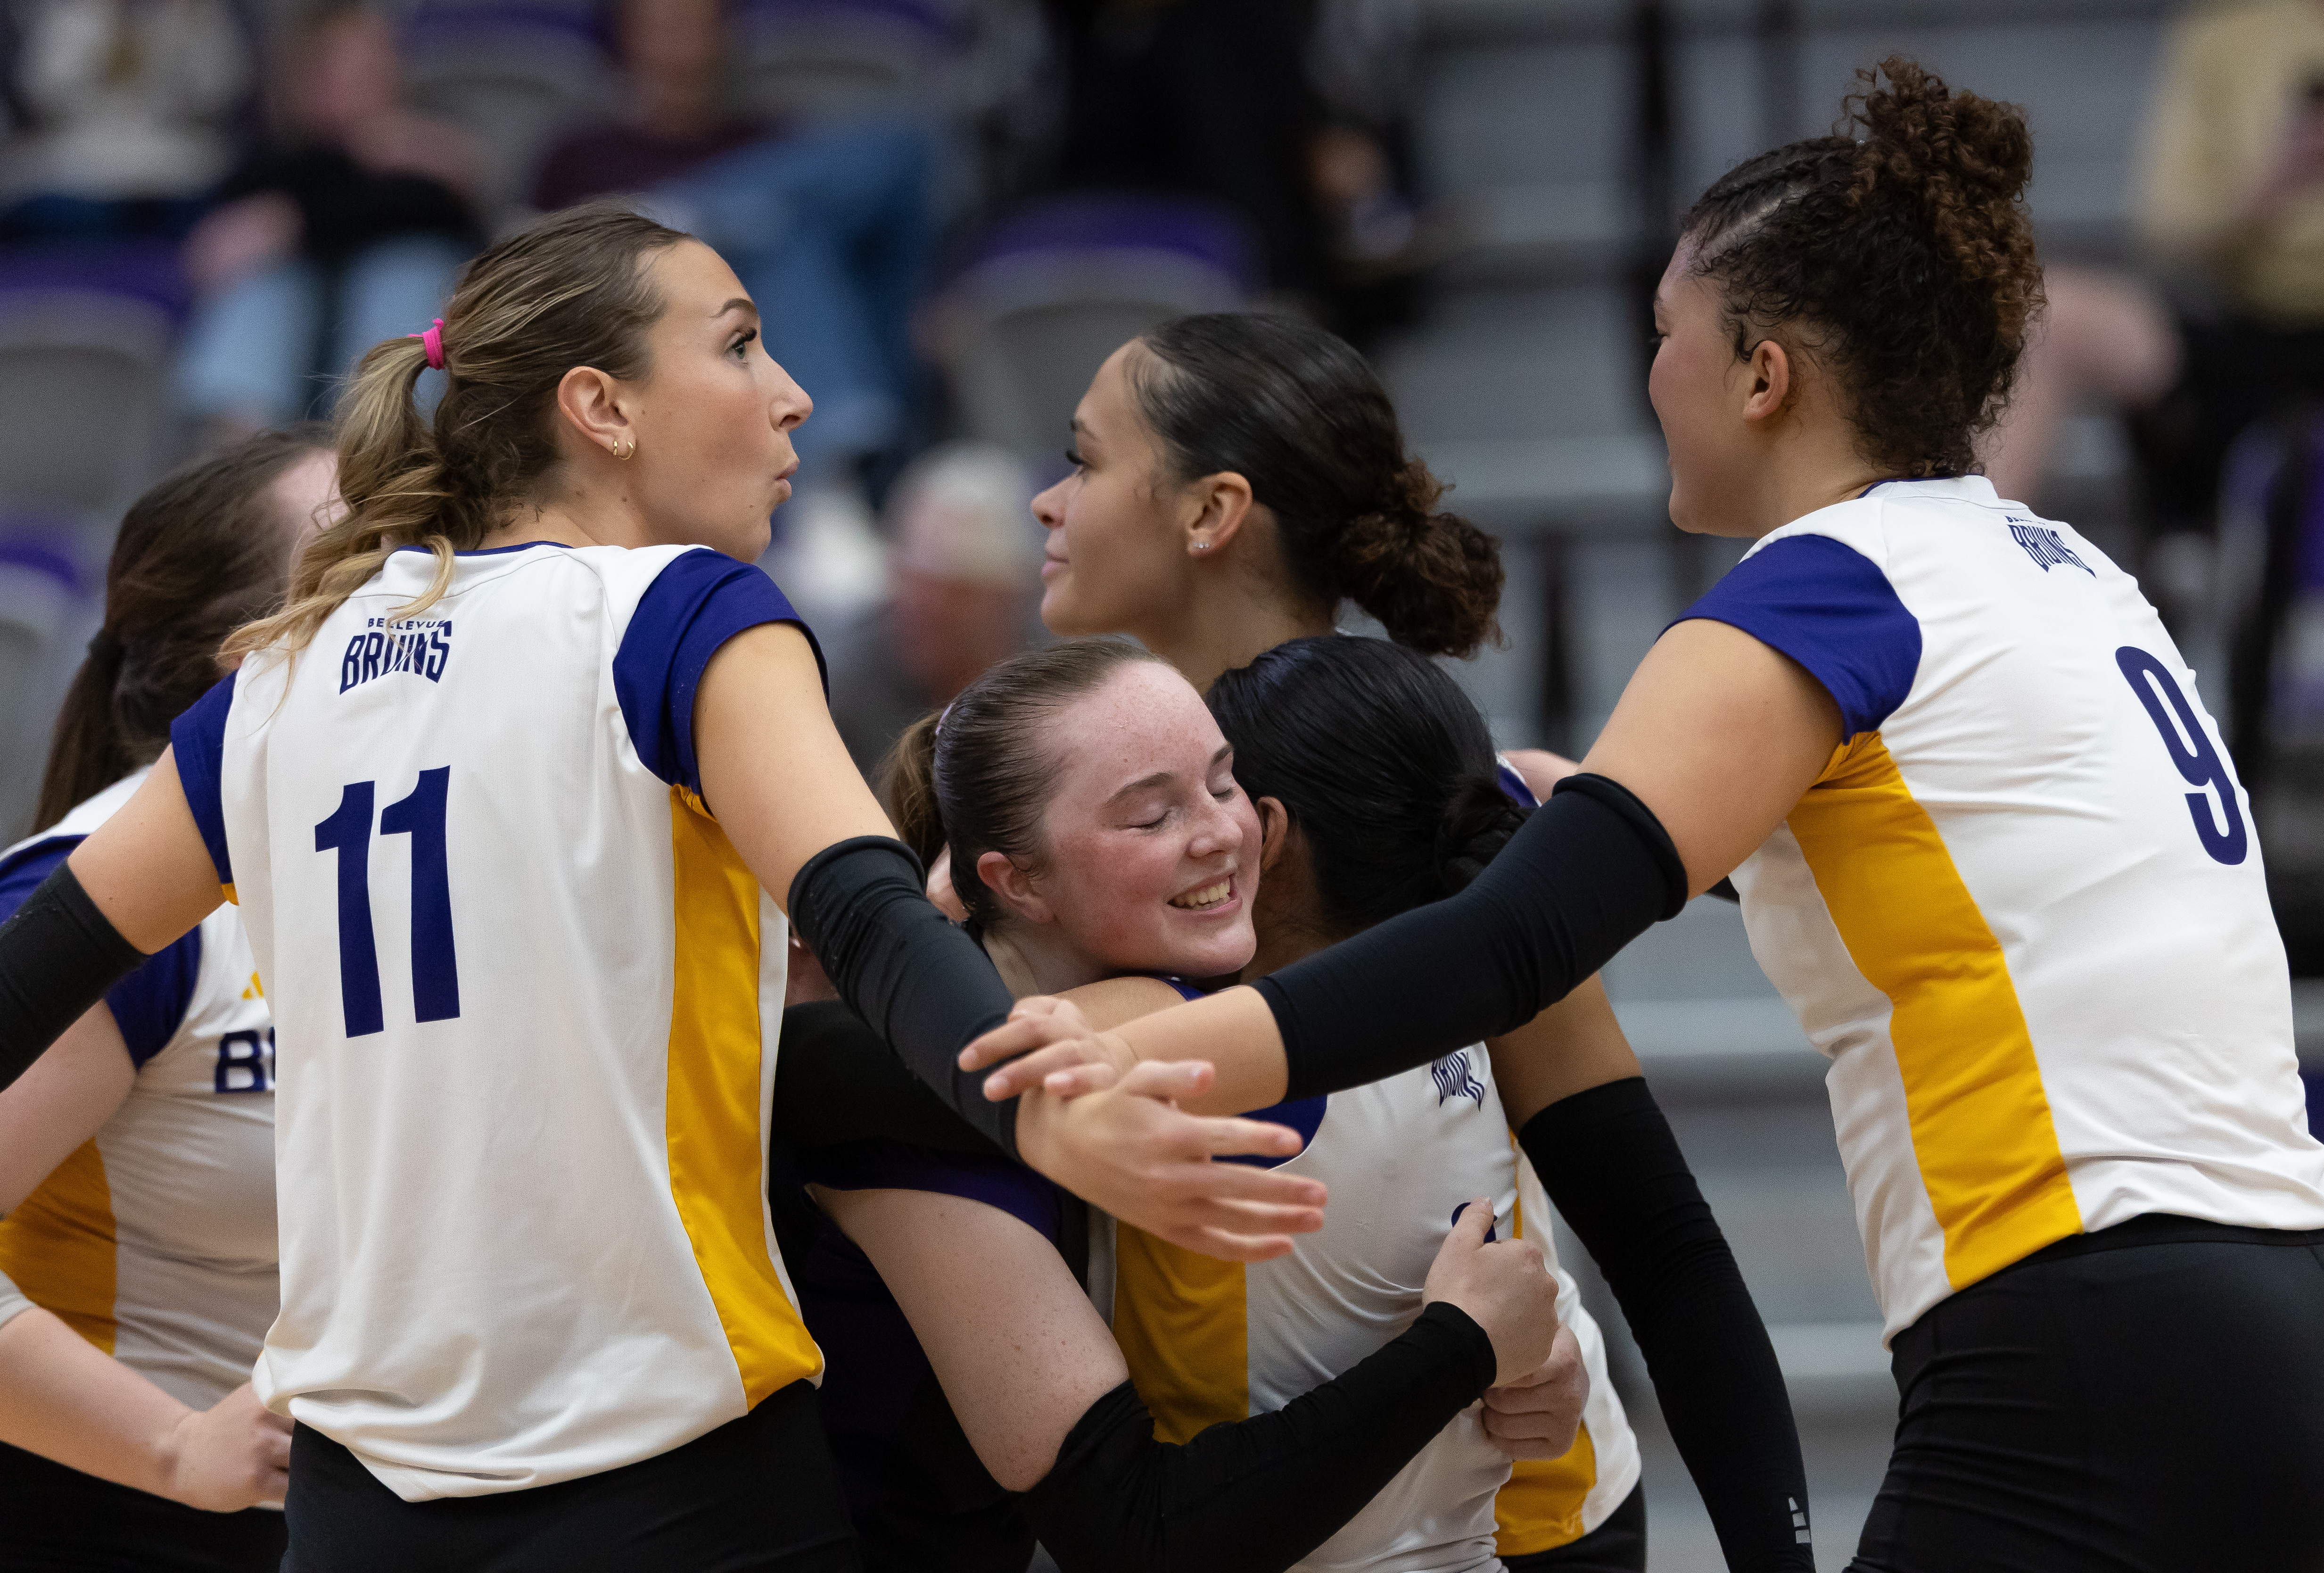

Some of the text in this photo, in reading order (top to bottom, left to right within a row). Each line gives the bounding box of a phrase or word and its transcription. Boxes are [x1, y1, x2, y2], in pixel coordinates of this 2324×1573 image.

[339, 620, 452, 695] BRUINS
[2115, 646, 2247, 865] 9
[314, 764, 461, 1039] 11
[215, 1027, 276, 1093] B
